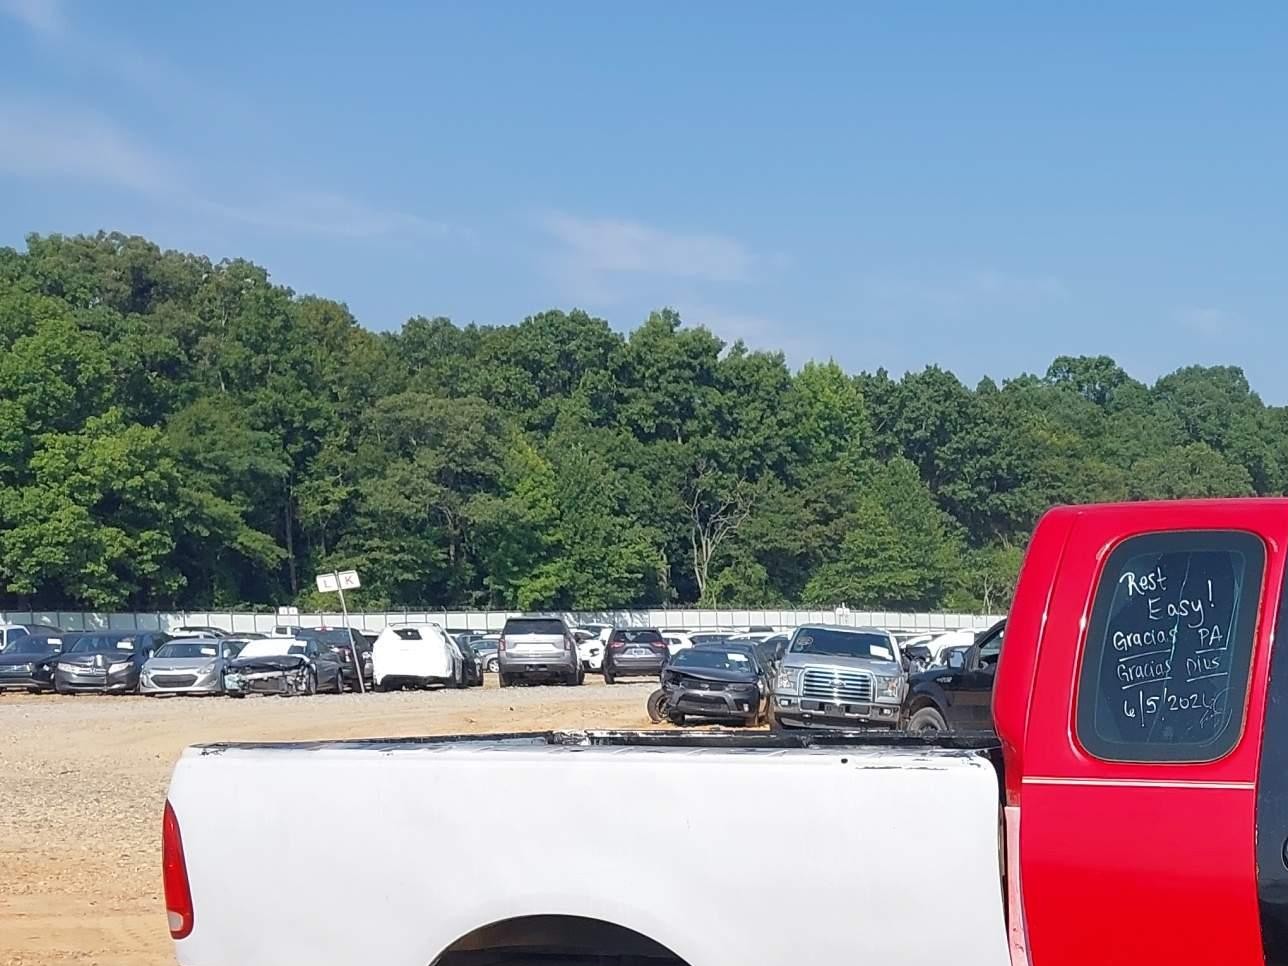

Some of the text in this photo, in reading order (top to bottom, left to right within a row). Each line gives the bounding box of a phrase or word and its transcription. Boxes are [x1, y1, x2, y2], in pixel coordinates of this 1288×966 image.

[344, 575, 354, 585] K
[1119, 566, 1167, 596] Rest
[1113, 624, 1223, 651] Gracias PA
[1117, 659, 1171, 682] Gracias
